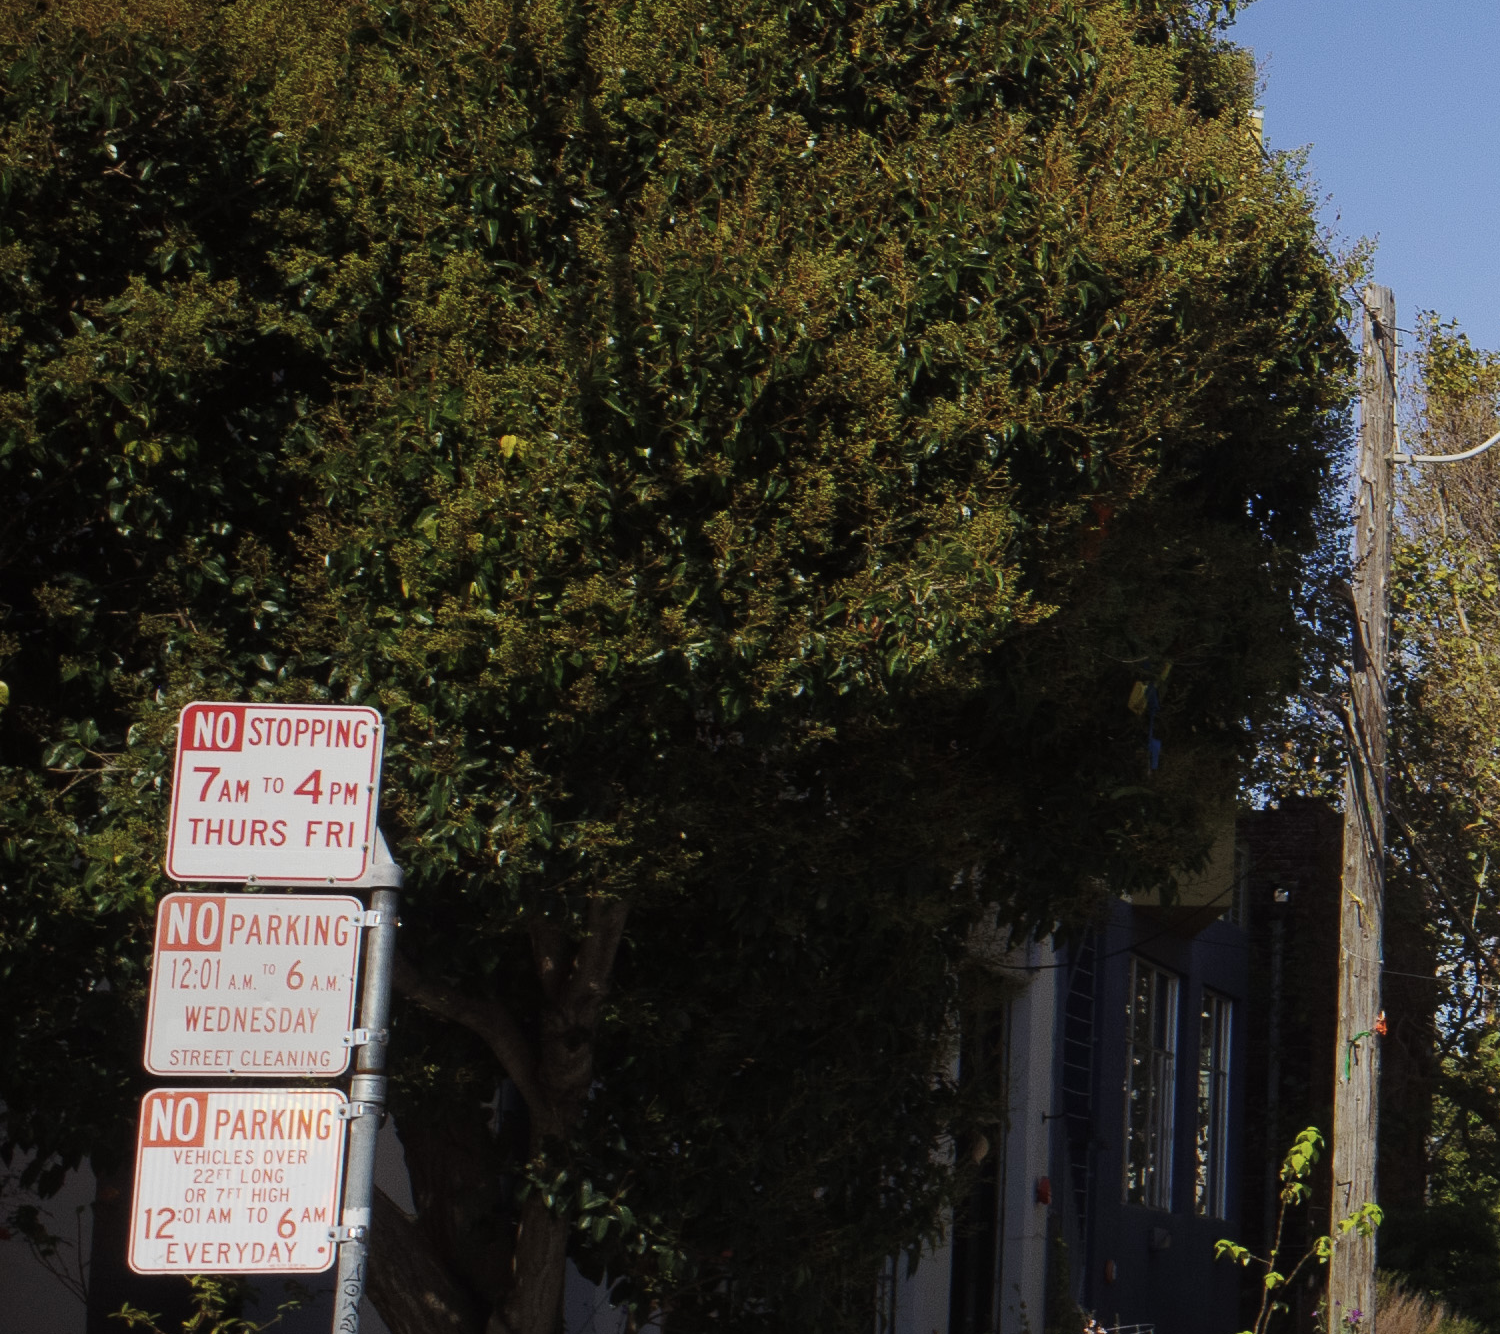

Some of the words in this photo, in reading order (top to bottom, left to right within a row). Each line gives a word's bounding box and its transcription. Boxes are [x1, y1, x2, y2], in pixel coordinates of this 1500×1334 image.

[193, 711, 236, 749] NO
[249, 717, 368, 749] STOPPING
[263, 777, 284, 794] TO
[188, 818, 287, 846] THURS
[305, 821, 355, 848] FRI
[166, 901, 219, 946] NO
[229, 914, 349, 946] PARKING
[171, 958, 221, 990] 12:01
[228, 974, 257, 990] A.M.
[262, 963, 276, 975] TO
[286, 959, 304, 990] 6
[310, 975, 341, 991] A.M.
[185, 1005, 320, 1033] WEDNESDAY
[169, 1049, 233, 1066] STREET
[240, 1050, 331, 1067] CLEANING
[150, 1097, 199, 1142] NO
[214, 1108, 332, 1141] PARKING
[174, 1149, 254, 1165] VEHICLES
[263, 1150, 308, 1165] OVER
[240, 1169, 284, 1184] LONG
[184, 1188, 206, 1203] OR
[251, 1188, 289, 1203] HIGH
[247, 1207, 268, 1224] TO
[166, 1242, 298, 1264] EVERYDAY
